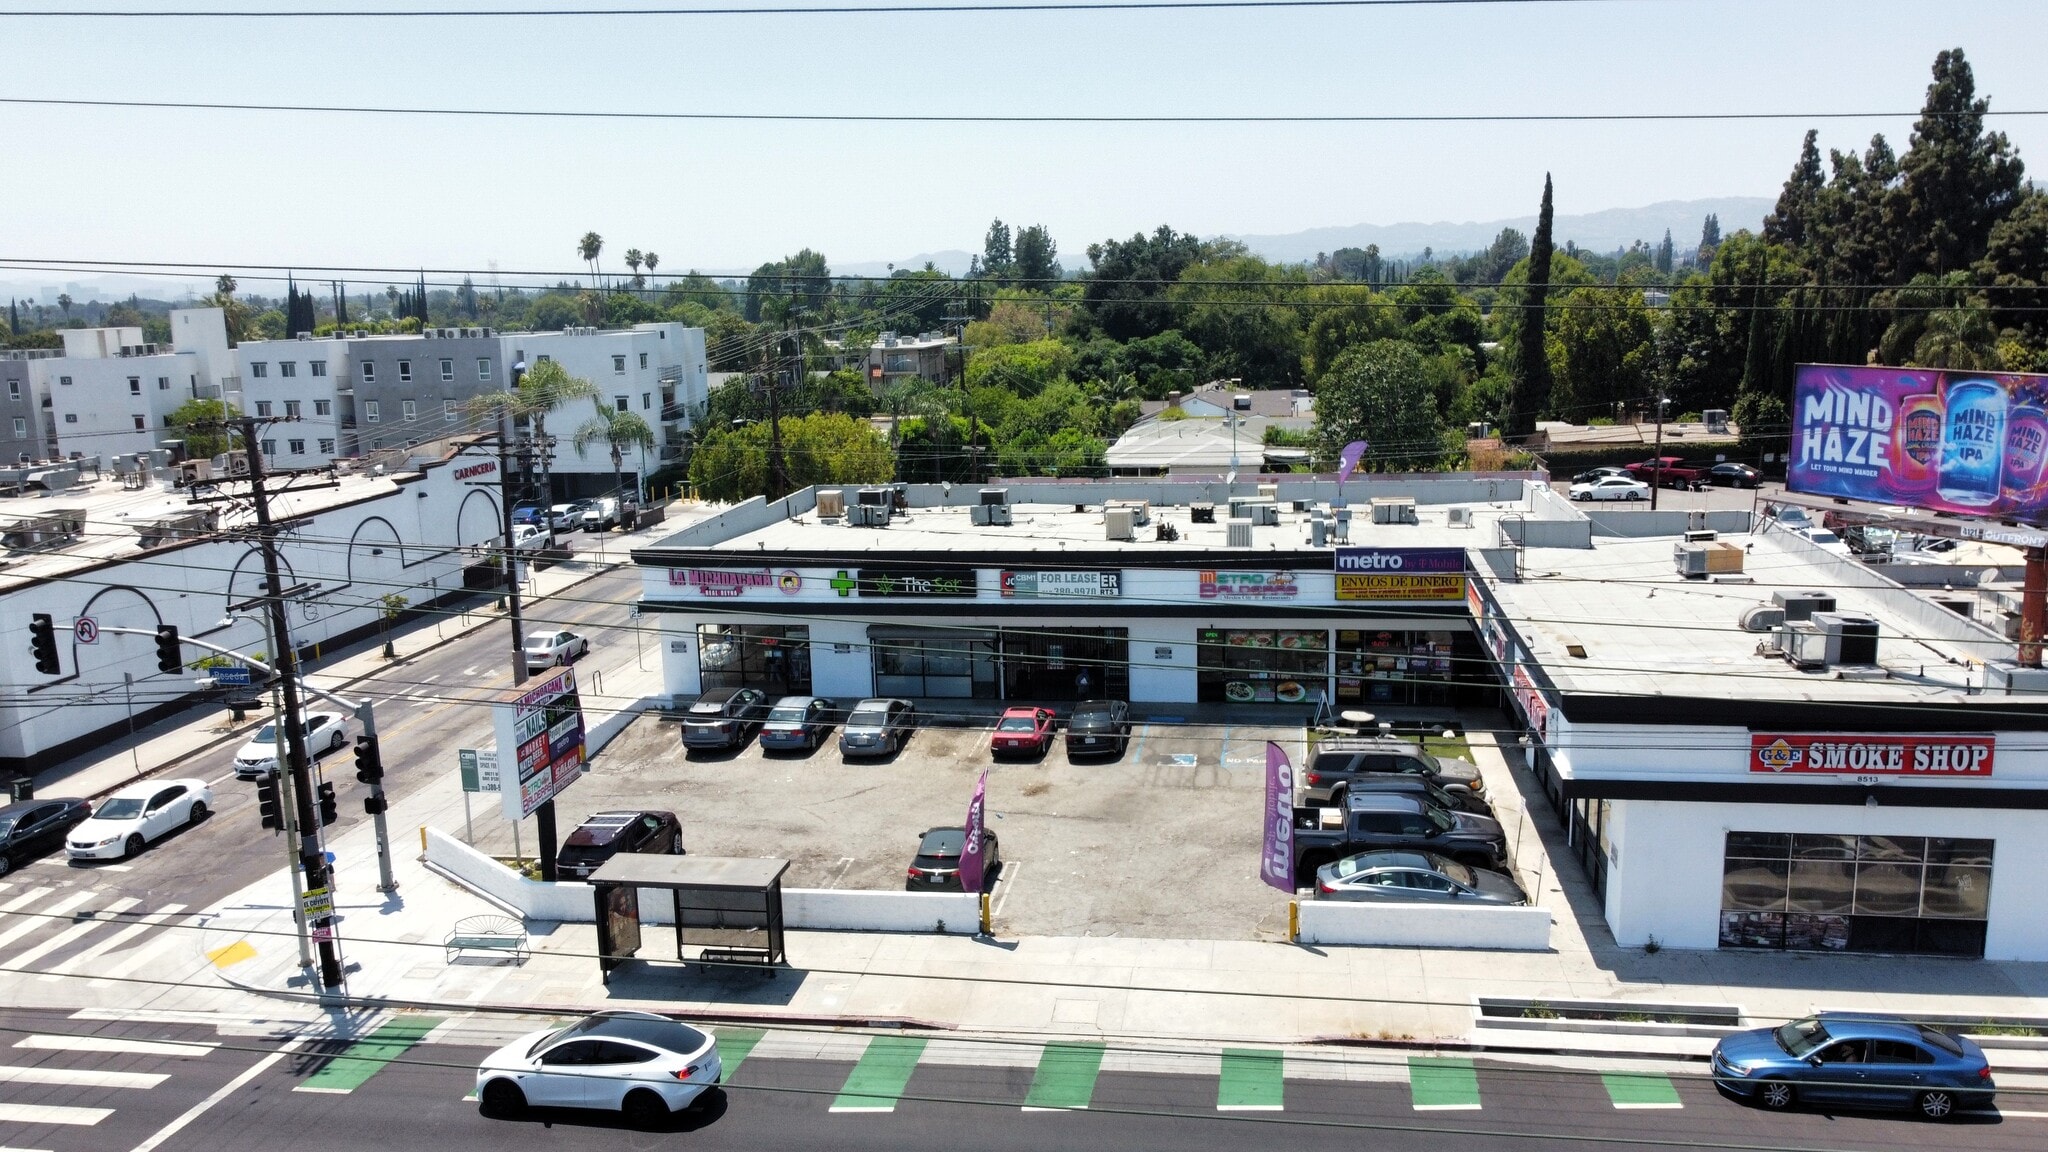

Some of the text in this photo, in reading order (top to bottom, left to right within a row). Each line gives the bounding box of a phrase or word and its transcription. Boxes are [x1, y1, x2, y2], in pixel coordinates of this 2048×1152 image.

[1803, 387, 1893, 433] MIND
[1955, 408, 1996, 429] MIND
[1907, 416, 1940, 431] MIND
[1907, 429, 1940, 441] HAZE
[1953, 425, 1995, 444] HAZE
[2010, 426, 2042, 444] MIND
[1799, 426, 1892, 468] HAZE
[1960, 447, 1983, 461] IPA
[2007, 437, 2040, 454] HAZE
[454, 461, 497, 480] CARNICERIA
[1811, 463, 1878, 477] LET YOUR MIND WANDER
[2011, 458, 2025, 469] IPA
[1962, 527, 1978, 537] 4121
[1985, 530, 2046, 547] OUTFRONT
[1339, 551, 1403, 569] metro
[668, 567, 687, 586] LA
[901, 576, 963, 592] The Set
[1040, 573, 1098, 583] FOR LEASE
[1199, 570, 1264, 584] METRO
[1390, 577, 1408, 587] DE
[1410, 576, 1459, 587] DINERO
[213, 670, 245, 681] Reseda
[525, 709, 546, 739] NAILS
[525, 734, 546, 757] MARKET
[1760, 742, 1989, 771] G&E SMOKE SHOP
[967, 802, 981, 855] metro
